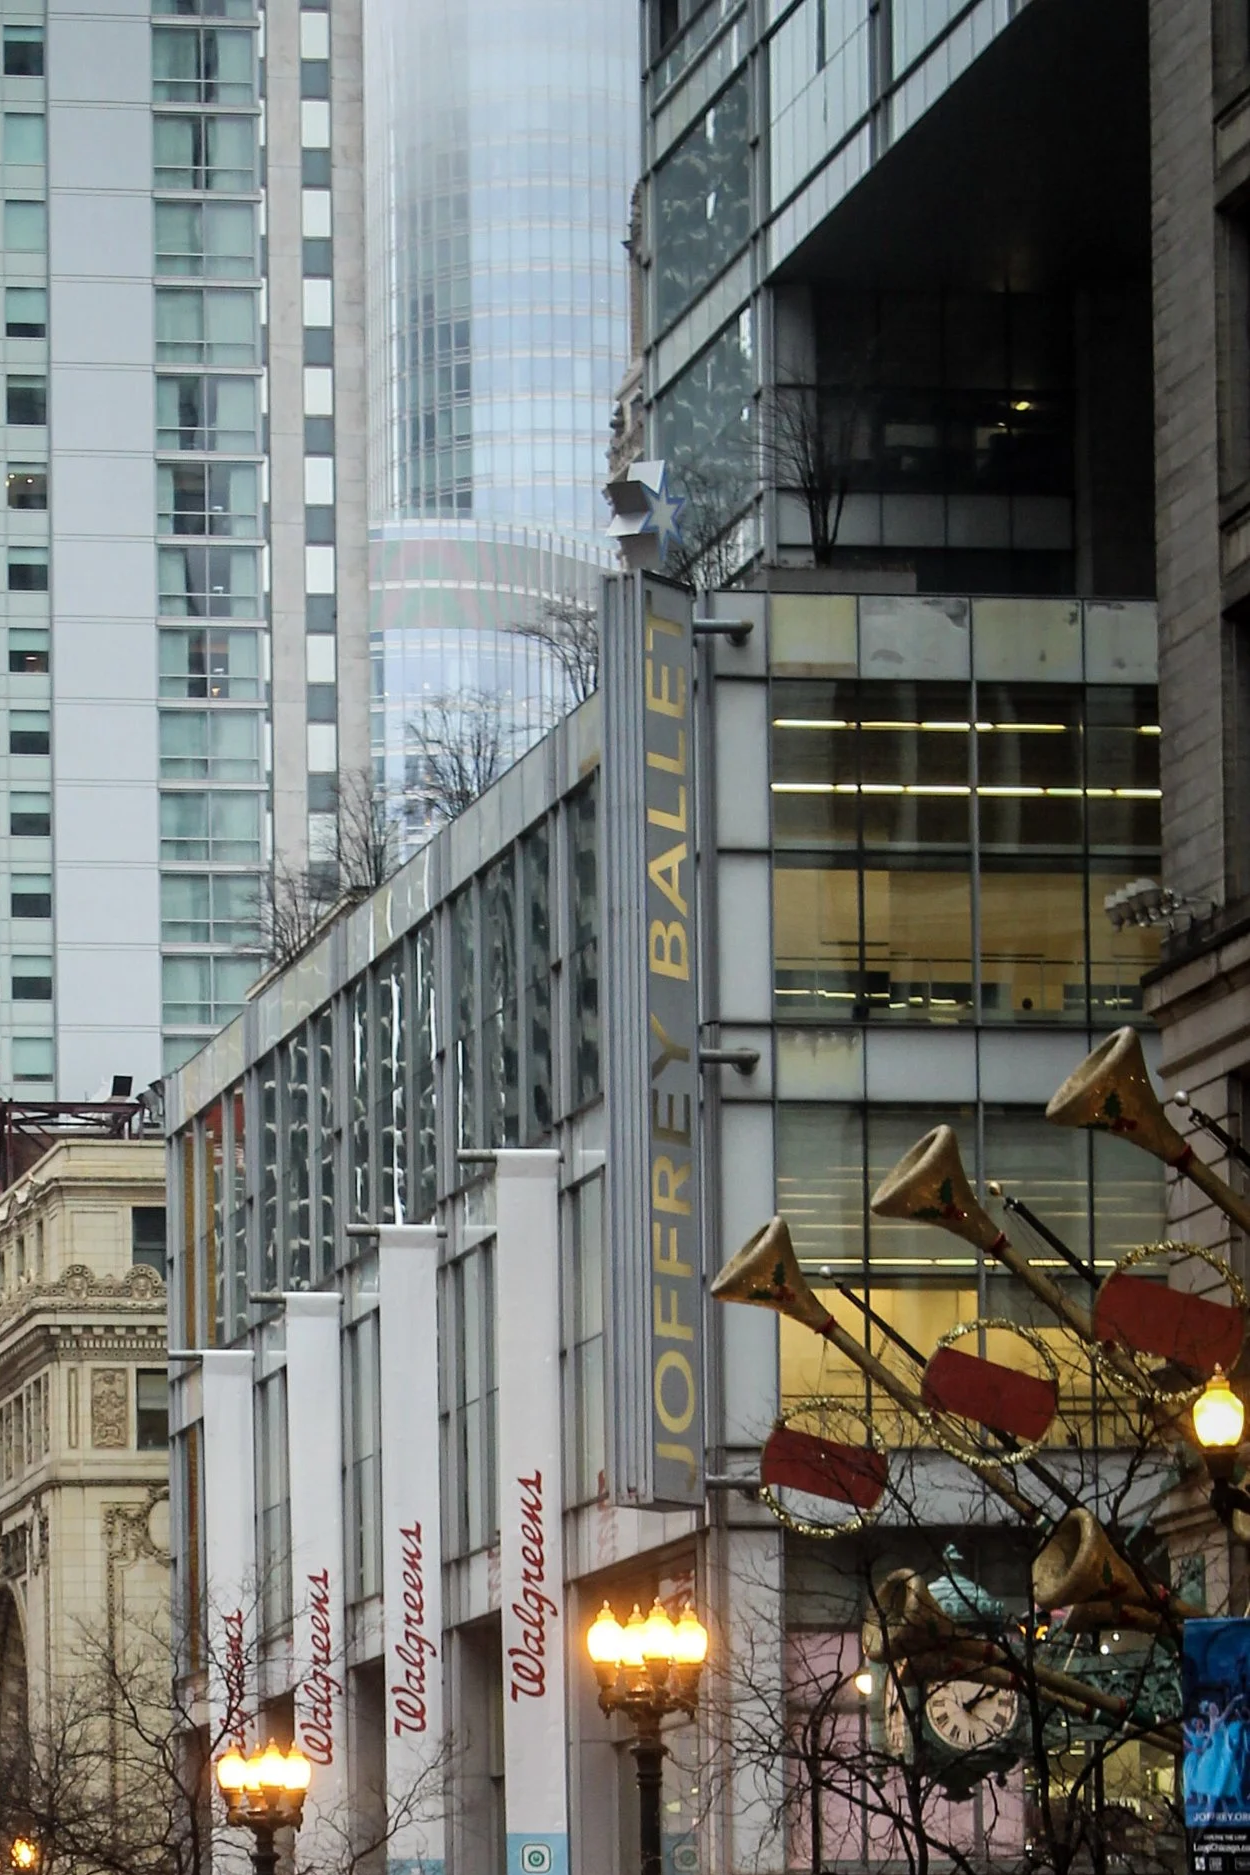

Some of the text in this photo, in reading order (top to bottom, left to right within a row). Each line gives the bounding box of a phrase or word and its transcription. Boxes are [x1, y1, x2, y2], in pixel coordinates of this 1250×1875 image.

[645, 590, 697, 1492] JOFFREY BALLET
[300, 1567, 343, 1767] Walgreens
[391, 1520, 437, 1737] Walgreens
[507, 1469, 558, 1704] Walgreens
